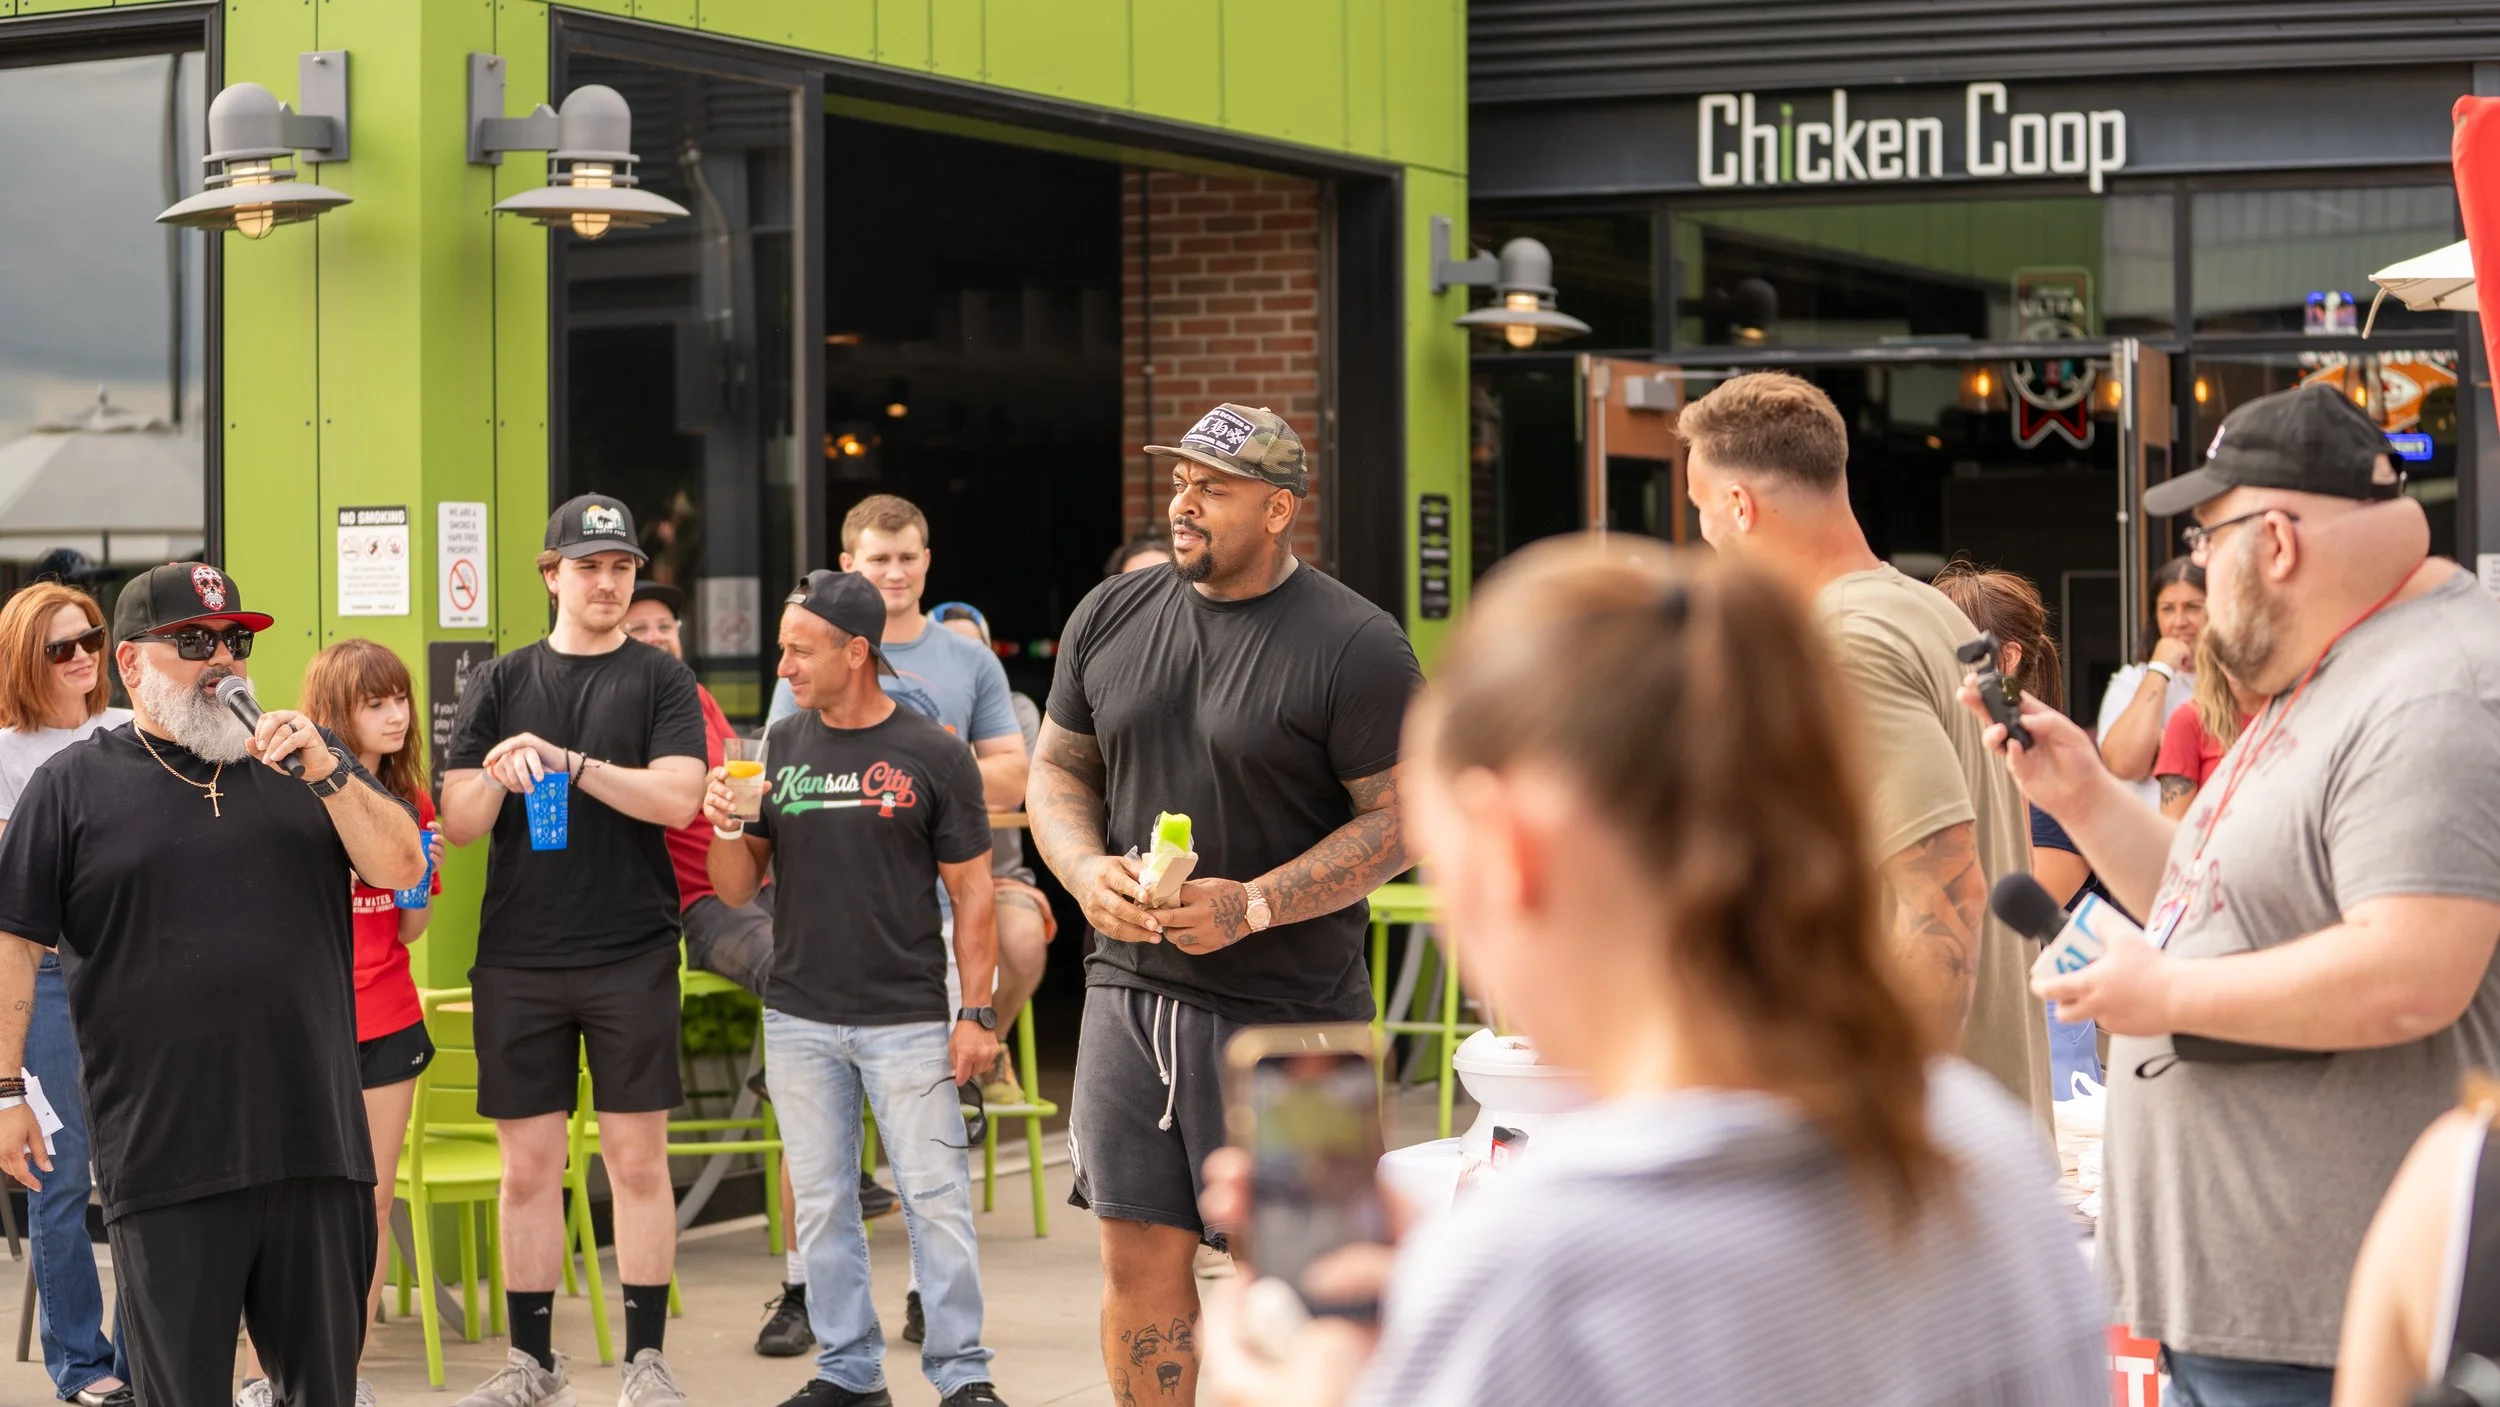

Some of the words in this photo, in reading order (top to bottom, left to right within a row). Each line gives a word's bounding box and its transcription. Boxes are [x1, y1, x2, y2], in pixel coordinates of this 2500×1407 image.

[1699, 88, 1943, 187] Chicken
[1966, 82, 2127, 193] Coop
[339, 510, 356, 526] NO
[357, 509, 406, 526] SMOKING
[449, 507, 458, 517] WE
[459, 507, 471, 517] ARE
[449, 520, 470, 530] SMOKE
[447, 533, 462, 542] VAPE
[464, 533, 479, 542] FREE
[447, 545, 478, 554] PROPERTY
[433, 701, 440, 714] If
[433, 718, 450, 732] play
[433, 733, 447, 745] You
[771, 763, 861, 805] Kansas
[861, 761, 914, 801] City
[364, 893, 392, 907] WATER
